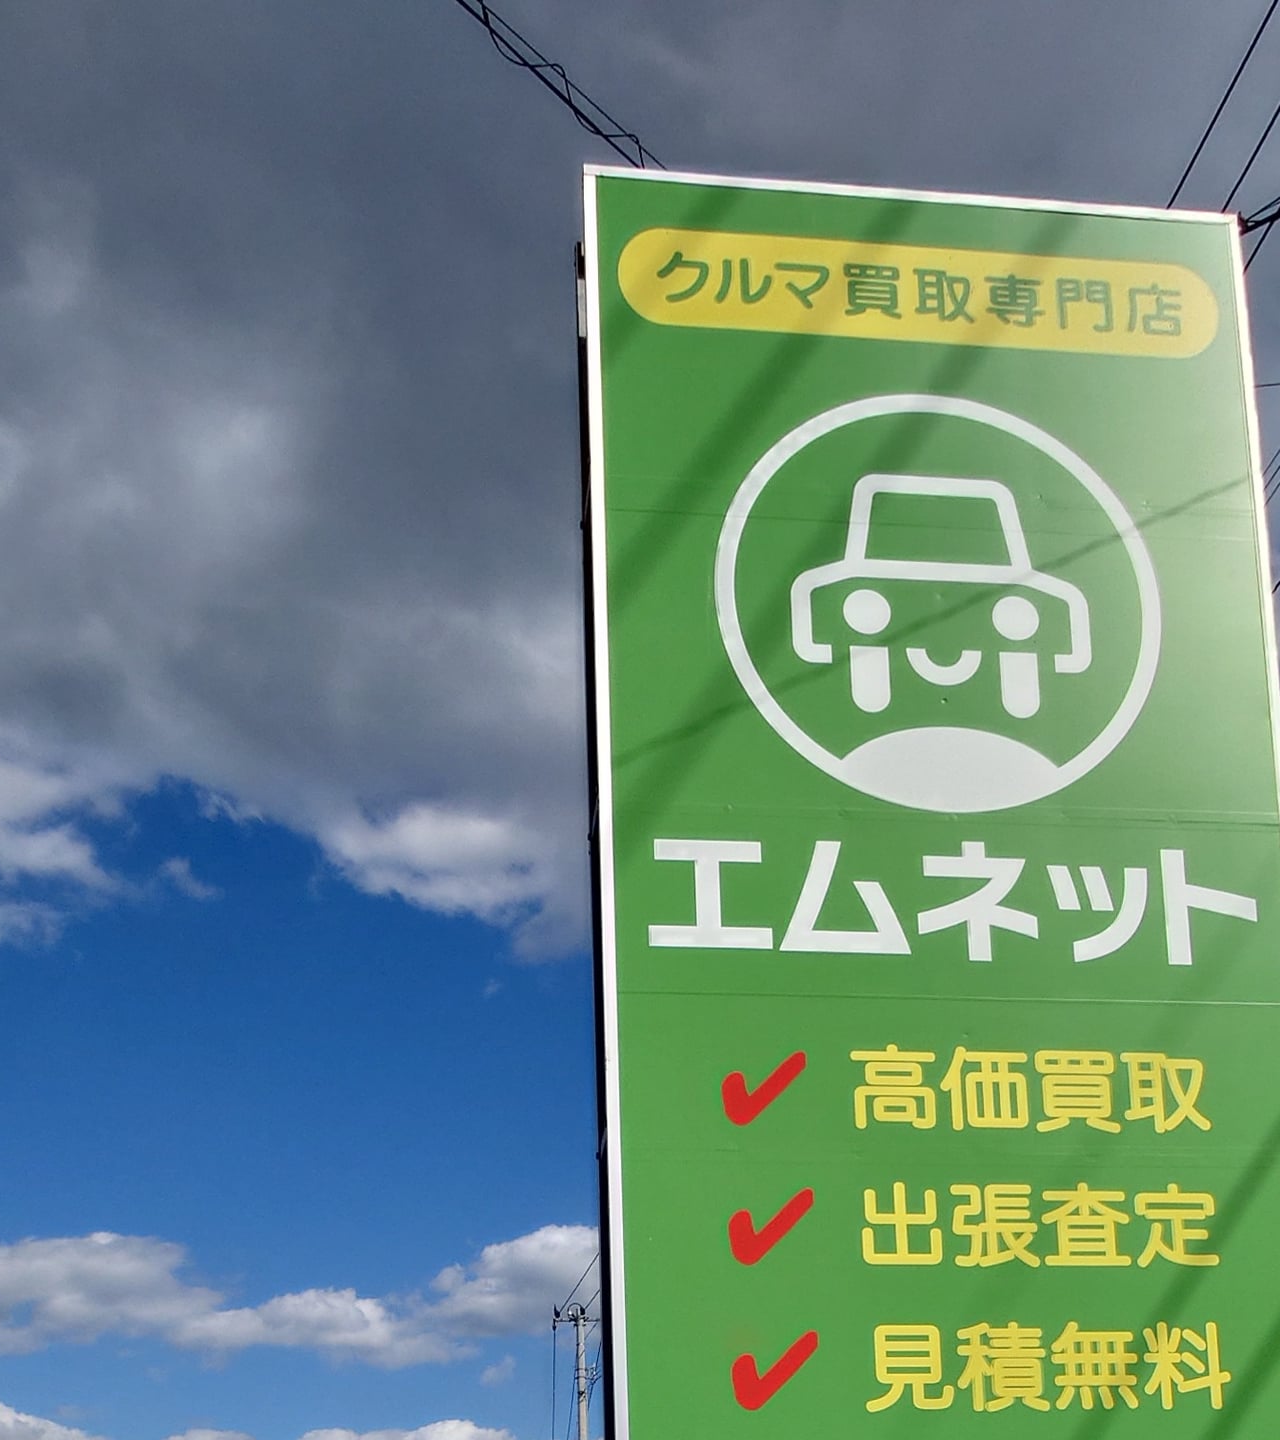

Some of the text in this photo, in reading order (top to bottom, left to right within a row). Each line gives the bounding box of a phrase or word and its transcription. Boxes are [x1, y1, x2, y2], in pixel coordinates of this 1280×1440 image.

[656, 252, 1183, 338] クルマ買取専門店
[648, 838, 1258, 965] エムネット
[850, 1044, 1212, 1133] 高価買取
[861, 1182, 1221, 1268] 出張査定
[866, 1321, 1231, 1413] 見積無料
